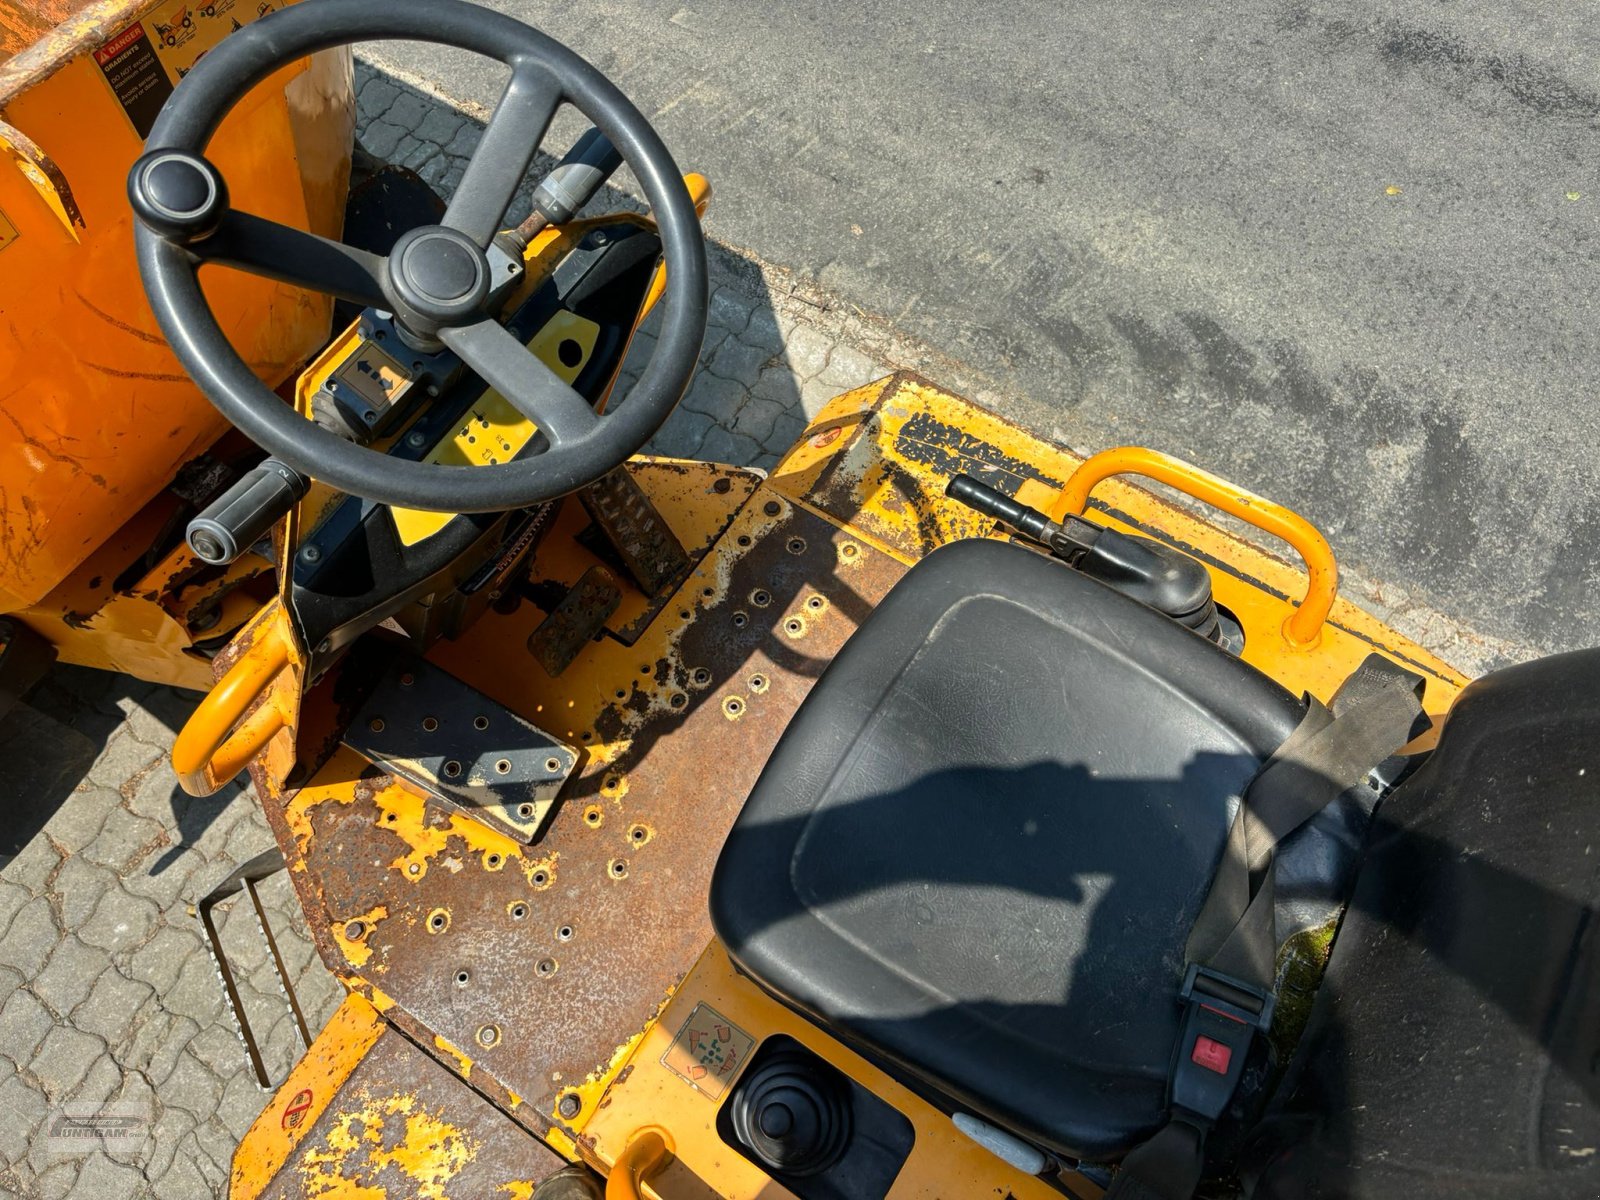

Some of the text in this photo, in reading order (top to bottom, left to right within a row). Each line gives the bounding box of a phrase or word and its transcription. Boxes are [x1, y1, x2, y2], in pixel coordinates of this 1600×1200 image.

[109, 27, 142, 54] DANGER
[104, 45, 139, 72] GRADIENTS
[111, 52, 151, 84] DO NOT exceed
[115, 57, 155, 89] maximum stated
[138, 72, 157, 87] serious
[124, 94, 138, 107] injury
[144, 78, 159, 91] death
[278, 468, 289, 478] 2
